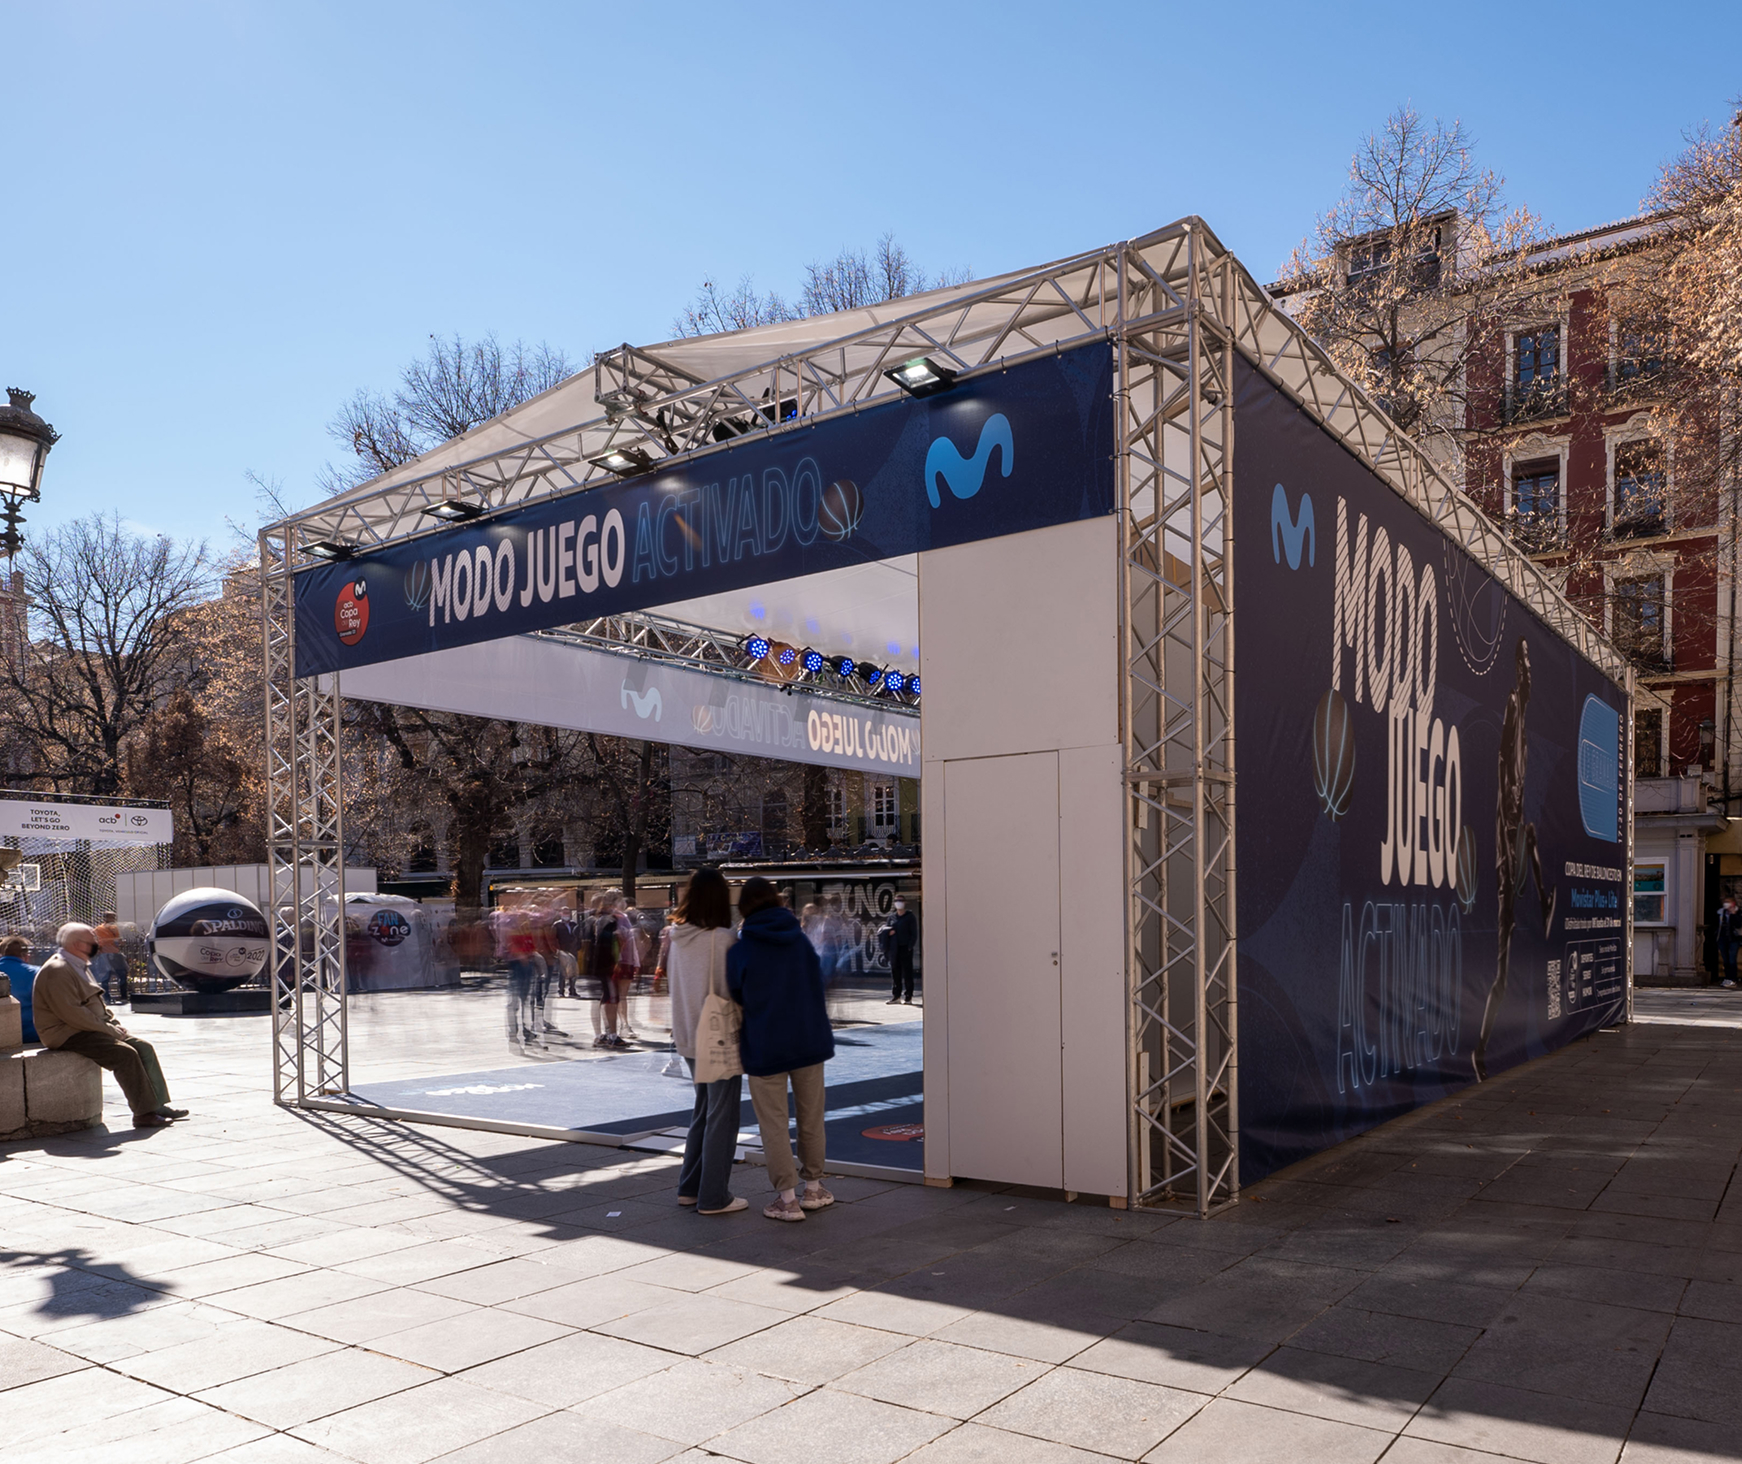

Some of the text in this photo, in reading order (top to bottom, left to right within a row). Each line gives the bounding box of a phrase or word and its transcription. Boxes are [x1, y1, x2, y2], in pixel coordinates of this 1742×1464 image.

[428, 456, 822, 628] MODO JUEGO ACTIVADO
[340, 607, 358, 619] Copa
[1332, 495, 1438, 722] MODO
[348, 618, 361, 629] Rey
[1381, 698, 1462, 890] JUEGO
[1618, 783, 1624, 802] DE
[30, 809, 61, 817] TOYOTA,
[98, 816, 118, 825] acb
[1565, 861, 1576, 877] COPA
[1571, 887, 1618, 909] Movistar Plus+ Lite
[377, 912, 399, 926] FAN
[200, 919, 265, 936] SPALDING
[200, 947, 222, 957] Copa
[247, 949, 265, 962] 2022
[1337, 900, 1463, 1094] ACTIVADO
